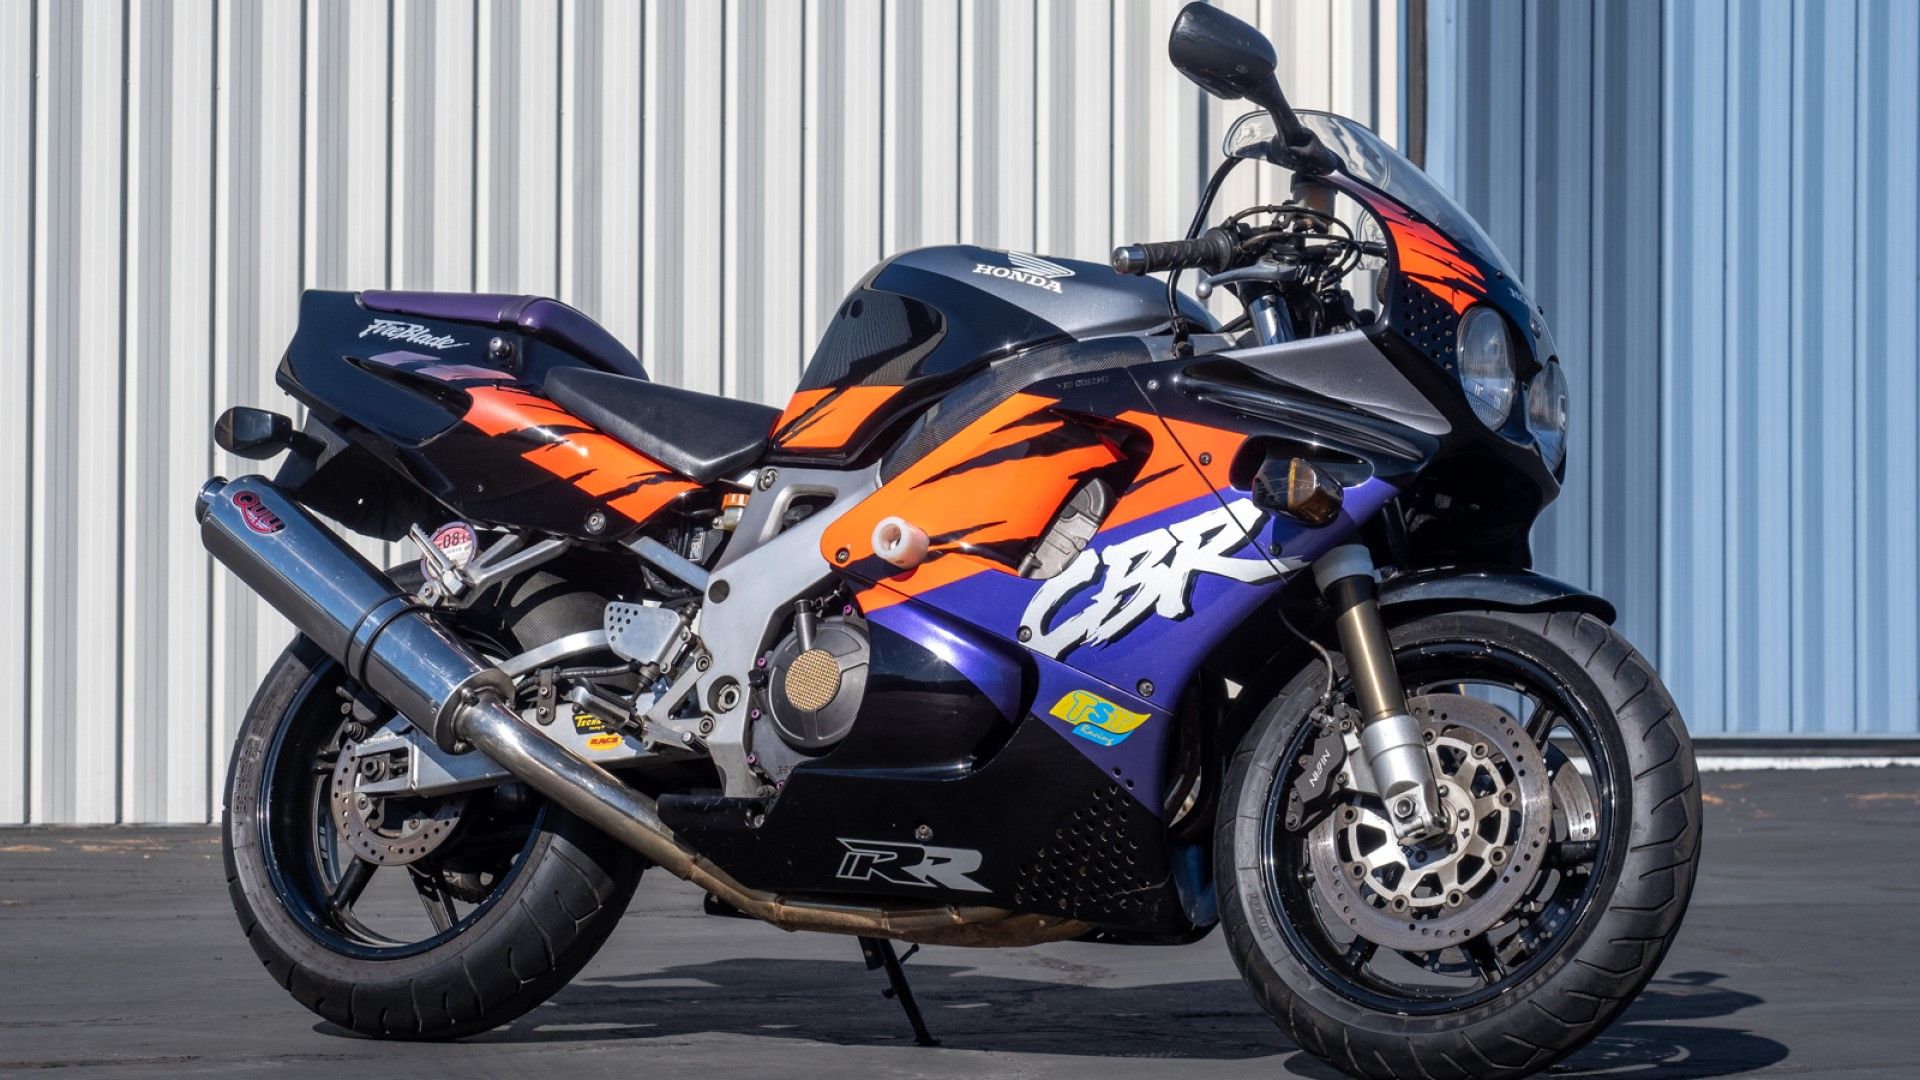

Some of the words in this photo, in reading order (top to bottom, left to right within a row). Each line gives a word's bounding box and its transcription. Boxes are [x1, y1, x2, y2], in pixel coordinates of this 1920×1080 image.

[972, 263, 1063, 294] HONDA
[359, 318, 470, 349] FireBlade
[1018, 497, 1308, 661] CBR
[834, 837, 995, 893] RR
